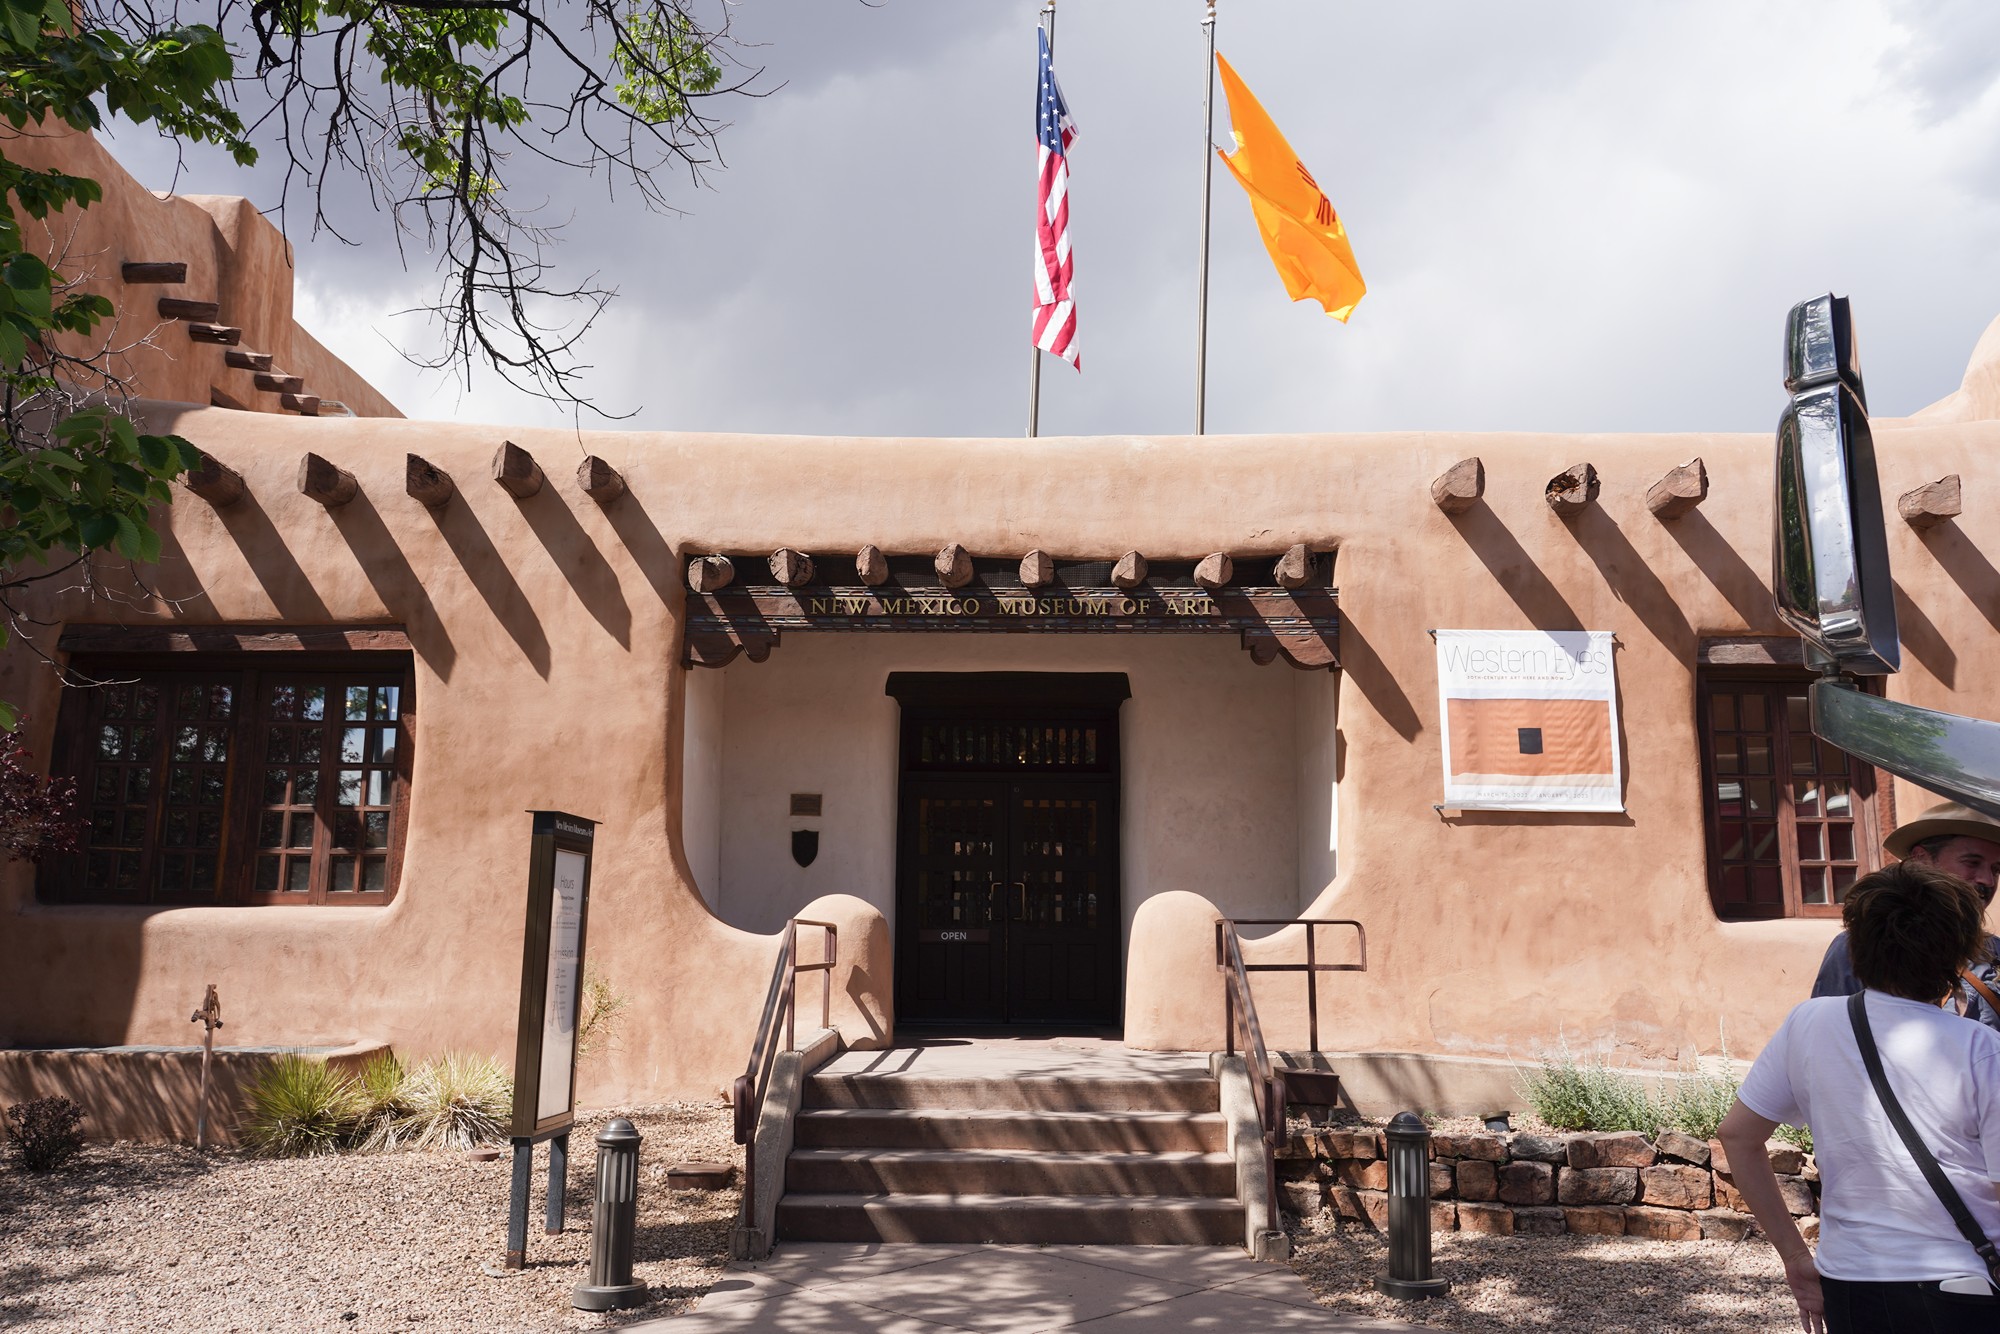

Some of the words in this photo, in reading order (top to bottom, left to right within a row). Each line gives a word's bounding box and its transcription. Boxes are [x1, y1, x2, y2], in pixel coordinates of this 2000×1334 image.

[810, 598, 869, 615] NEW
[881, 598, 980, 615] MEXICO
[999, 598, 1109, 615] MUSEUM
[1120, 598, 1150, 615] OF
[1165, 598, 1216, 615] ART
[1443, 645, 1548, 673] Western
[1553, 645, 1608, 681] Eyes
[560, 875, 574, 889] Hours
[941, 931, 967, 940] OPEN
